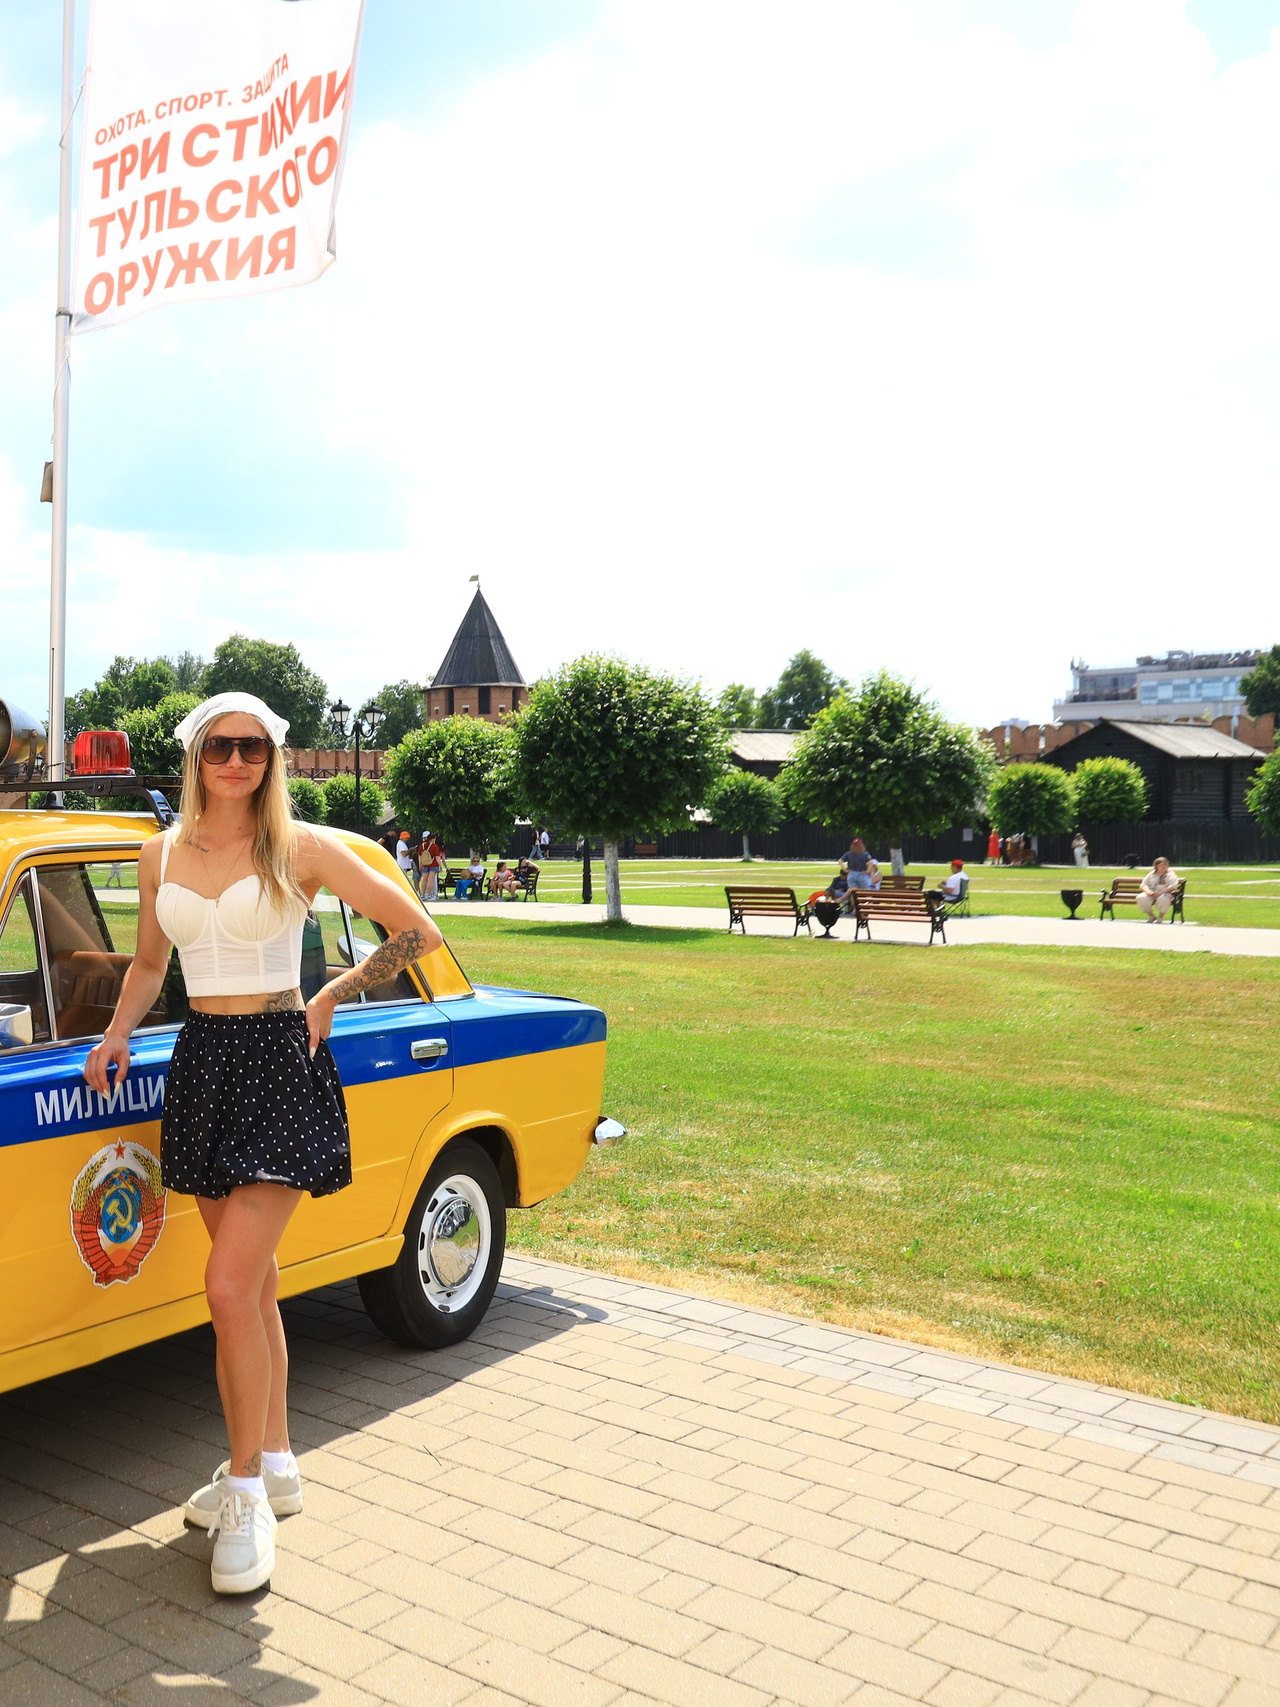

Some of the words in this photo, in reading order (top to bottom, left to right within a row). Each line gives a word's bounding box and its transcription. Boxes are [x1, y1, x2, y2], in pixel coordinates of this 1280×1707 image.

[92, 130, 171, 200] ТРИ
[181, 64, 352, 168] СТИХИИ
[95, 108, 151, 146] ОХОТА.
[154, 89, 232, 120] СПОРТ.
[88, 135, 339, 258] ТУЛЬСКОГО
[83, 225, 297, 316] ОРУЖИЯ
[34, 1074, 166, 1126] МИЛИЦИ
